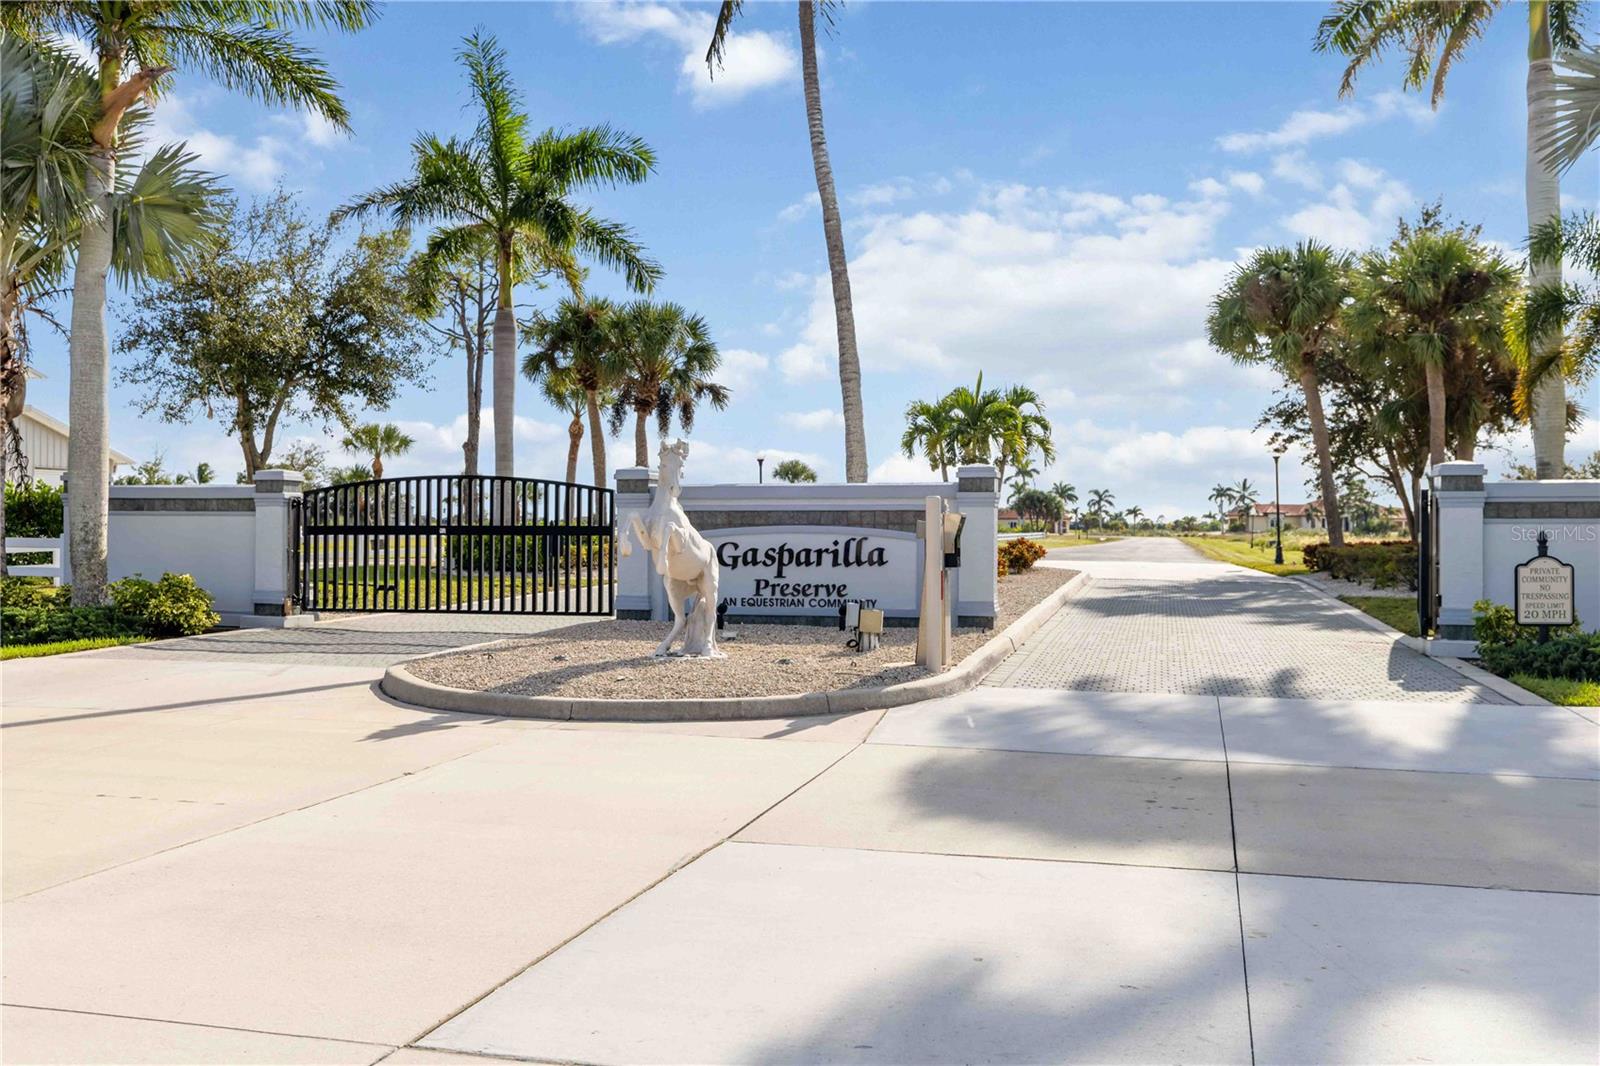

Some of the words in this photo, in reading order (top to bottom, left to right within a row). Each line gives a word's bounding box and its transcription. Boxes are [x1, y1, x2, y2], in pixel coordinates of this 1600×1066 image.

[717, 536, 889, 579] Gasparilla
[1530, 567, 1561, 575] PRIVATE
[1521, 575, 1569, 583] COMMUNITY
[753, 578, 848, 598] Preserve
[1521, 592, 1570, 600] TRESPASSING
[722, 597, 737, 607] AN
[740, 597, 805, 608] EQUESTRIAN
[808, 598, 877, 608] COMMTY
[1524, 610, 1539, 619] 20
[1542, 610, 1567, 619] MPH
